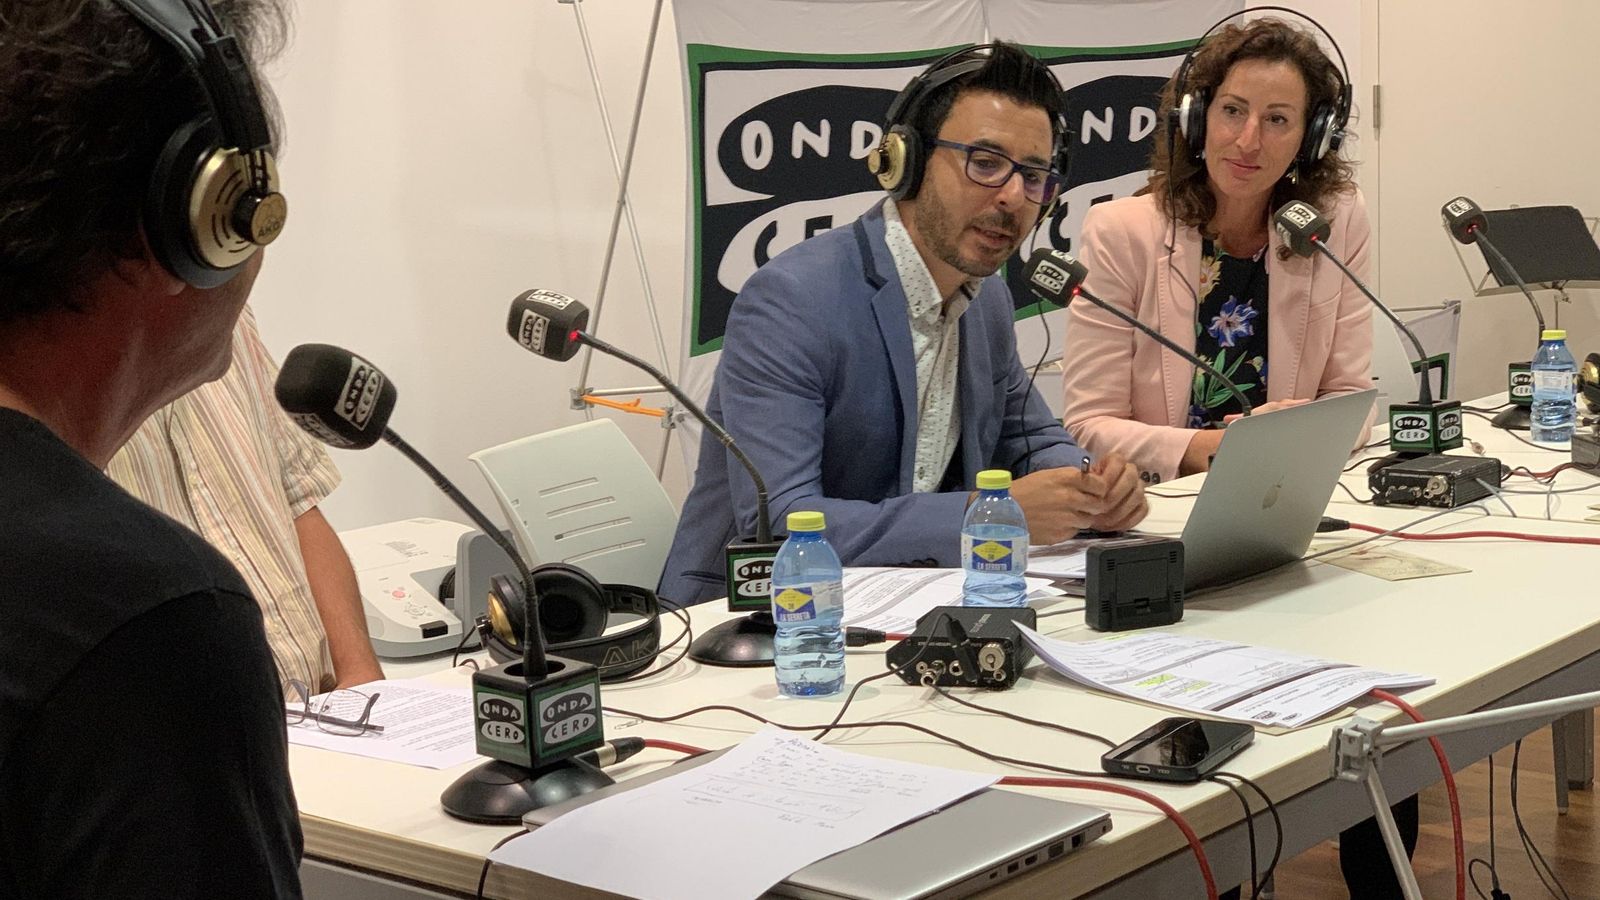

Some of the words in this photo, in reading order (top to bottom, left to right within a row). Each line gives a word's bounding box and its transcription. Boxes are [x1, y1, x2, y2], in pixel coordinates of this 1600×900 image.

[1081, 106, 1156, 144] ND
[741, 119, 883, 170] OND
[345, 370, 365, 410] ONDA
[1397, 419, 1426, 427] ONDA
[1442, 427, 1458, 438] CERO
[1400, 431, 1425, 439] CERO
[741, 565, 772, 576] OND
[601, 632, 655, 667] AK
[483, 702, 518, 719] ONDA
[547, 696, 588, 718] ONDA
[487, 724, 519, 740] CERO
[552, 717, 589, 738] CERO
